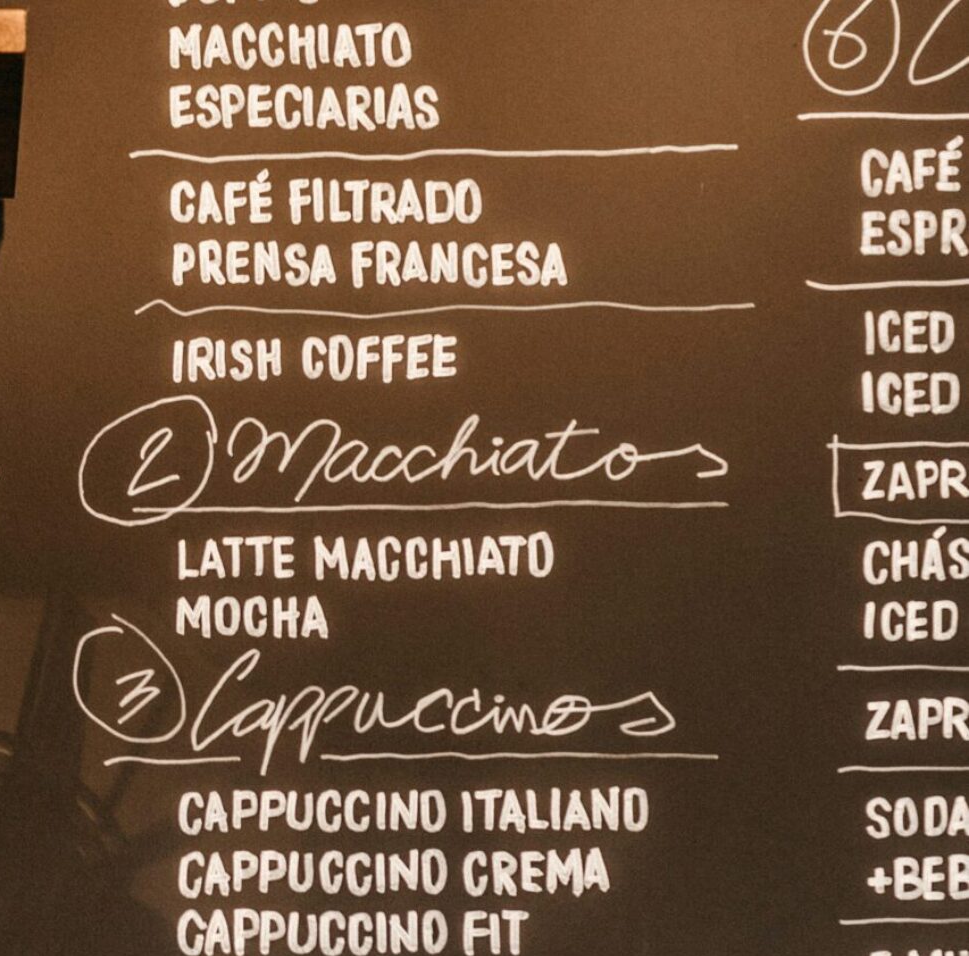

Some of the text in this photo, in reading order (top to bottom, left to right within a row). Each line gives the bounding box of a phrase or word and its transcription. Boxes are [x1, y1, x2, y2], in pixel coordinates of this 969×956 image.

[168, 21, 412, 71] MACCHIATO
[168, 82, 440, 132] ESPECIARIAS
[860, 135, 964, 198] CAFÉ
[169, 168, 483, 226] CAFÉ FILTRADO
[859, 208, 969, 257] ESPR
[171, 238, 568, 289] PRENSA FRANCESA
[864, 309, 955, 355] ICED
[172, 333, 458, 384] IRISH COFFEE
[861, 370, 960, 417] ICED
[127, 414, 728, 501] 2 Macchiatos
[177, 530, 555, 582] LATTE MACCHIATO
[862, 525, 969, 586] CHÁS
[175, 594, 329, 640] MOCHA
[863, 599, 959, 642] ICED
[115, 648, 677, 777] 3 Cappuccinos
[178, 785, 649, 836] CAPPUCCINO ITALIANO
[177, 846, 611, 899] CAPPUCCINO CREMA
[462, 909, 530, 956] FIT
